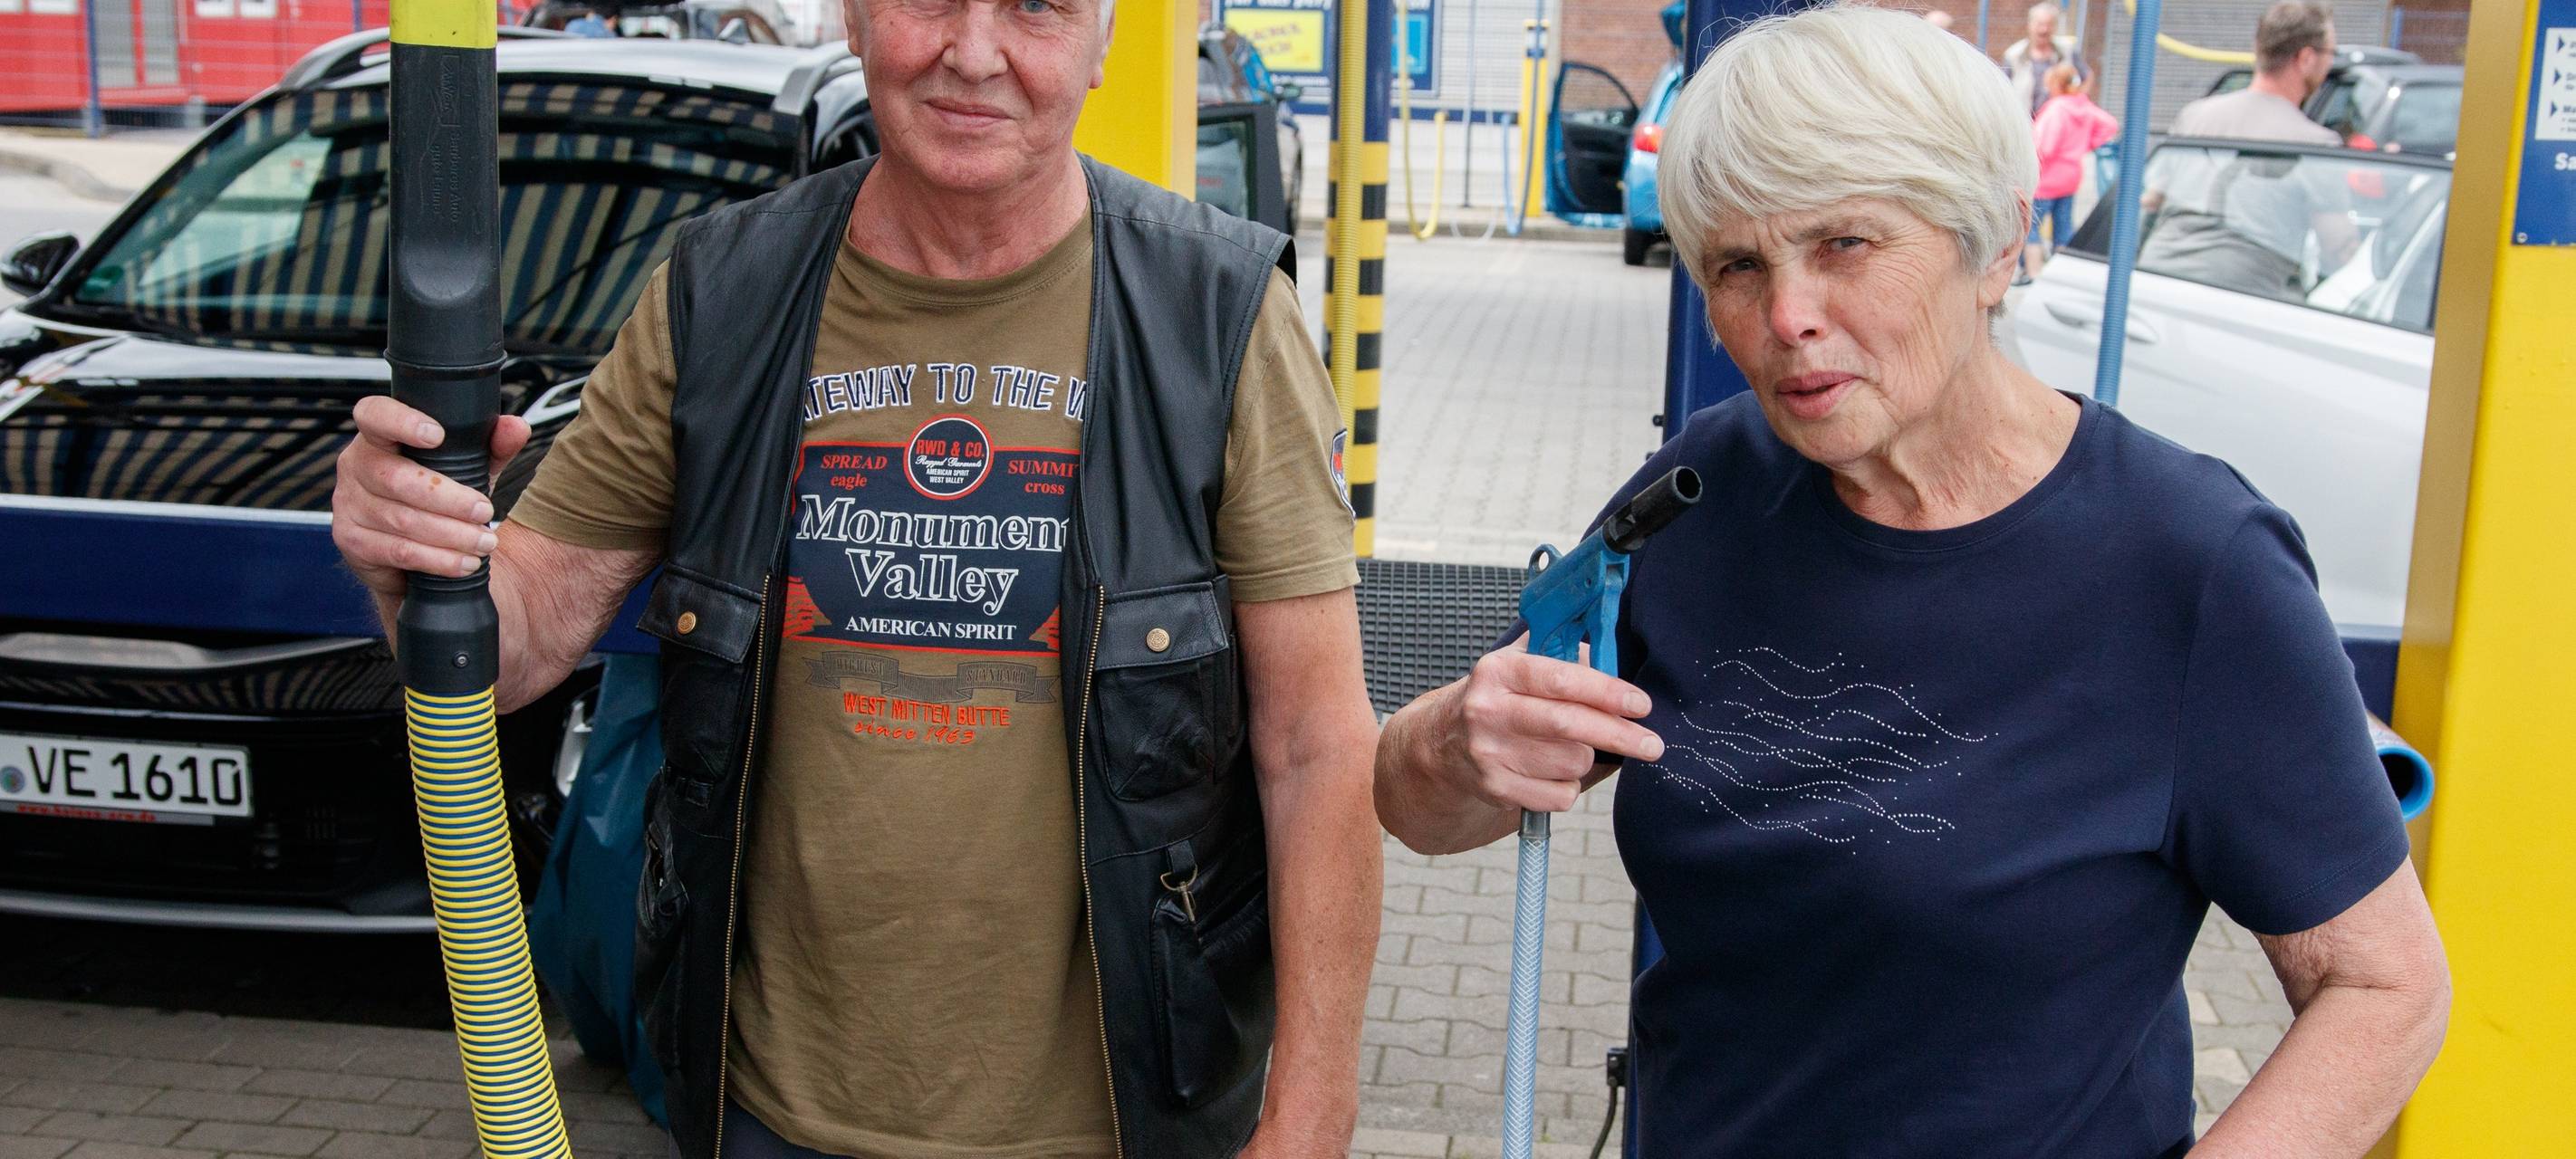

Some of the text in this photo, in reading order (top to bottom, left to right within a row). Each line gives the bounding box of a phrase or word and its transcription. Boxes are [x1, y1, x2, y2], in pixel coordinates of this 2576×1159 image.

[928, 362, 977, 404] TO
[991, 365, 1060, 410] THE
[916, 439, 947, 456] RWD
[950, 441, 960, 457] &
[821, 455, 888, 470] SPREAD
[915, 455, 948, 468] Rugged
[830, 474, 867, 488] eagle
[926, 468, 952, 476] AMERICAN
[929, 475, 944, 484] WEST
[1024, 483, 1065, 495] cross
[844, 547, 1019, 617] Valley
[844, 616, 1016, 640] AMERICAN SPIRIT
[843, 692, 1011, 726] WEST MITTEN BUTTE
[854, 718, 976, 744] since 1963
[27, 744, 244, 806] VE 1610
